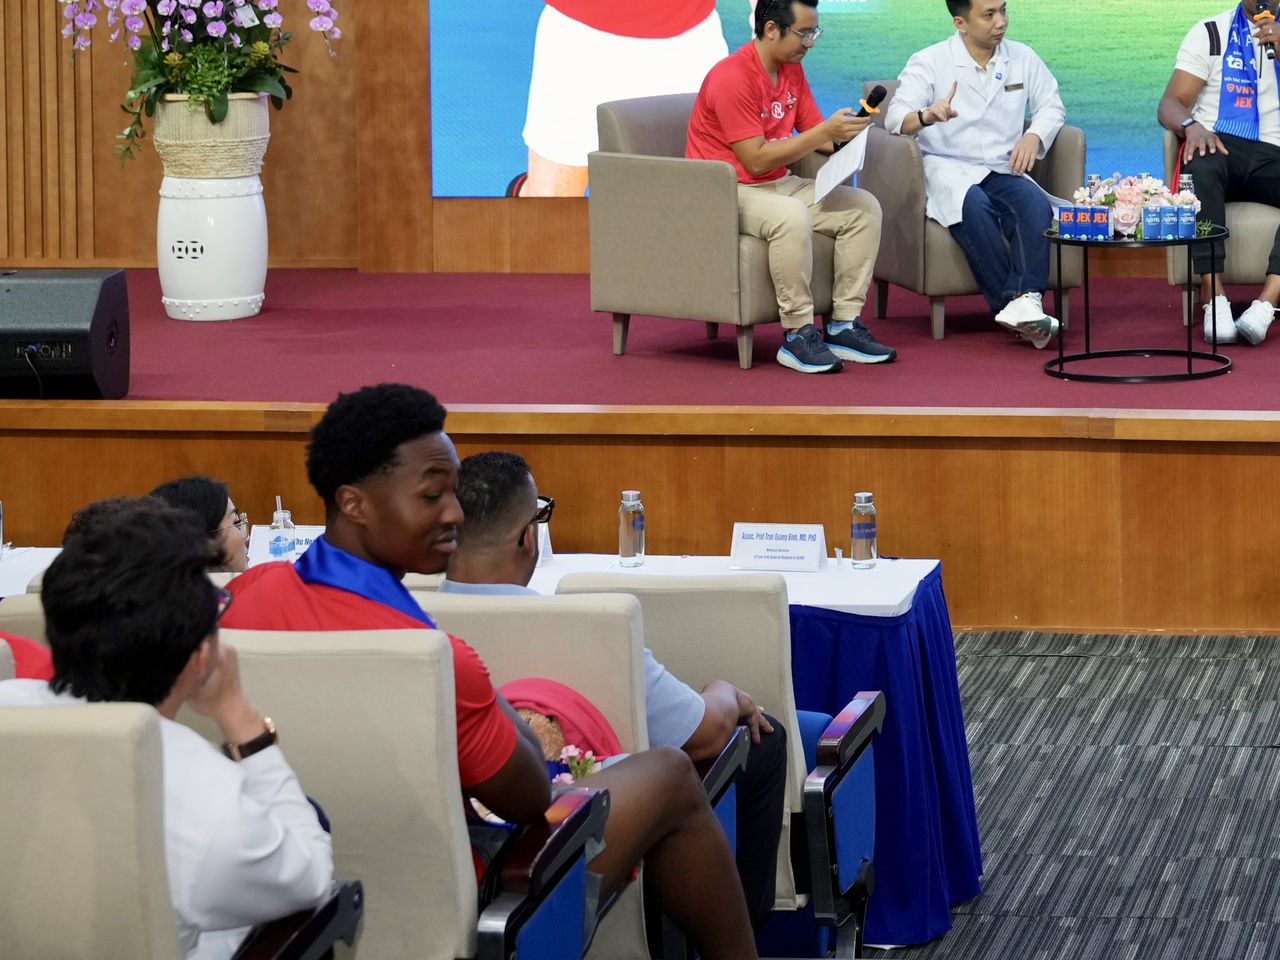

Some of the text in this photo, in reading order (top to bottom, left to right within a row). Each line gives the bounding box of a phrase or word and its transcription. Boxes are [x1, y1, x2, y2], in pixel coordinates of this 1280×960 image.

[1234, 96, 1253, 108] JEX
[1060, 212, 1074, 222] JEX
[1076, 212, 1090, 222] JEX
[1093, 212, 1108, 223] JEX
